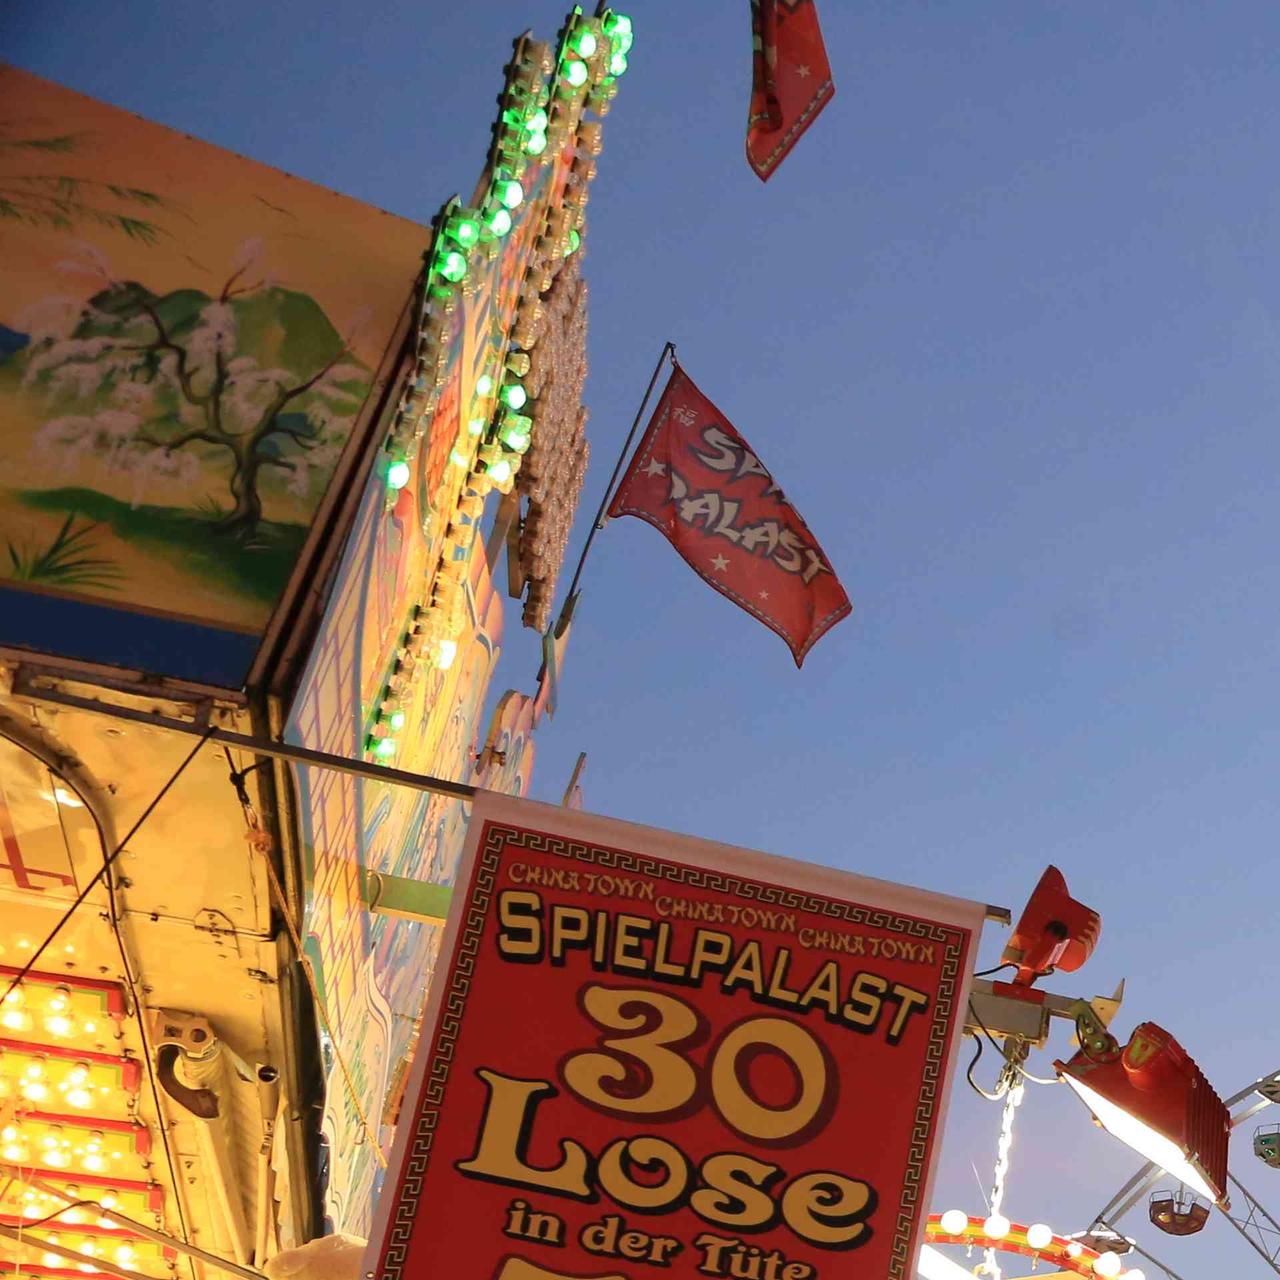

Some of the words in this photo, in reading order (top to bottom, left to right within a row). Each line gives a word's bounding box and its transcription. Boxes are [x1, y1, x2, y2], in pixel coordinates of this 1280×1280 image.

[499, 889, 930, 1042] SPIELPALAST
[563, 983, 828, 1141] 30
[454, 1067, 875, 1246] Lose
[505, 1200, 562, 1247] in
[583, 1216, 678, 1264] der
